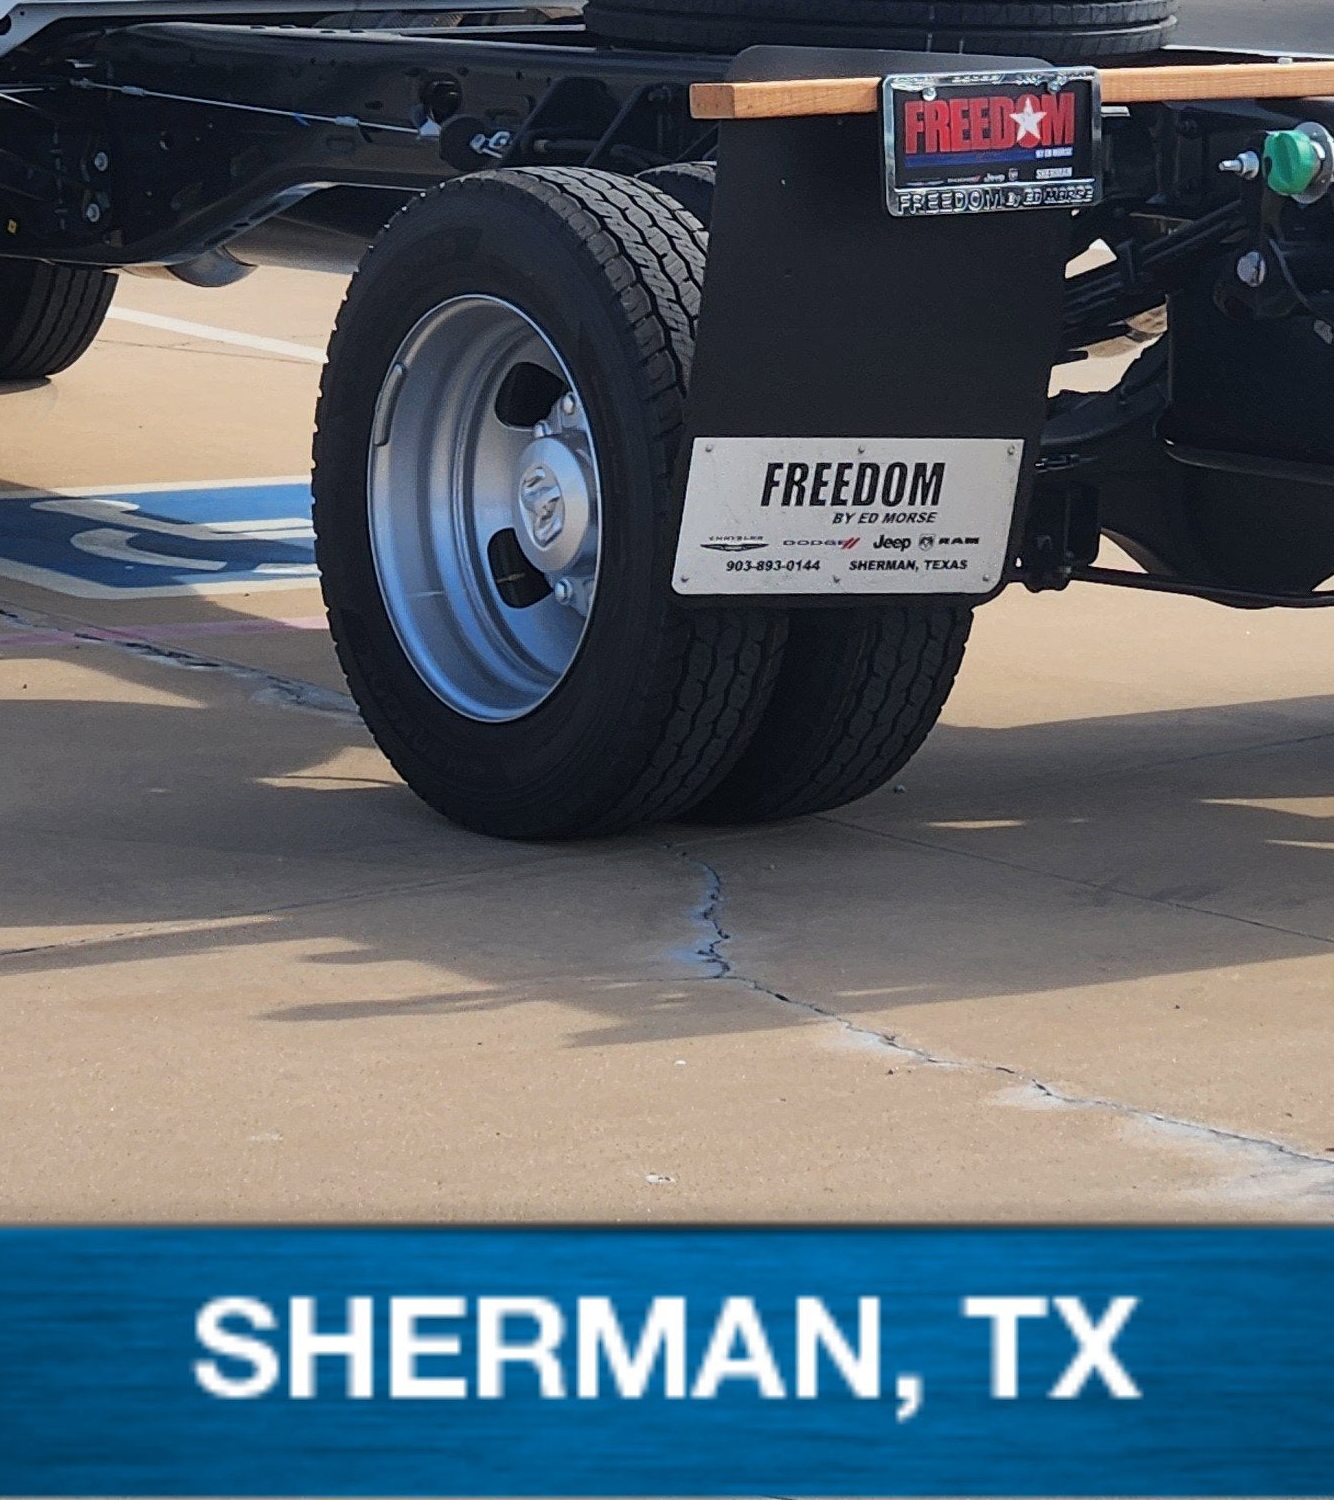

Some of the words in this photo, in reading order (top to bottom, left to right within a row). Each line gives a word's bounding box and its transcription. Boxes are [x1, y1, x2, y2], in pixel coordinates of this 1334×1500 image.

[904, 92, 1076, 156] FREEDOM
[897, 188, 1002, 216] FREEDOM
[760, 461, 946, 507] FREEDOM
[832, 512, 855, 524] BY
[857, 512, 878, 524] ED
[881, 512, 938, 524] MORSE
[873, 535, 912, 551] Jeep
[938, 537, 980, 545] RAM
[725, 559, 821, 572] 903-893-0144
[849, 559, 919, 572] SHERMAN,
[924, 559, 967, 571] TEXAS
